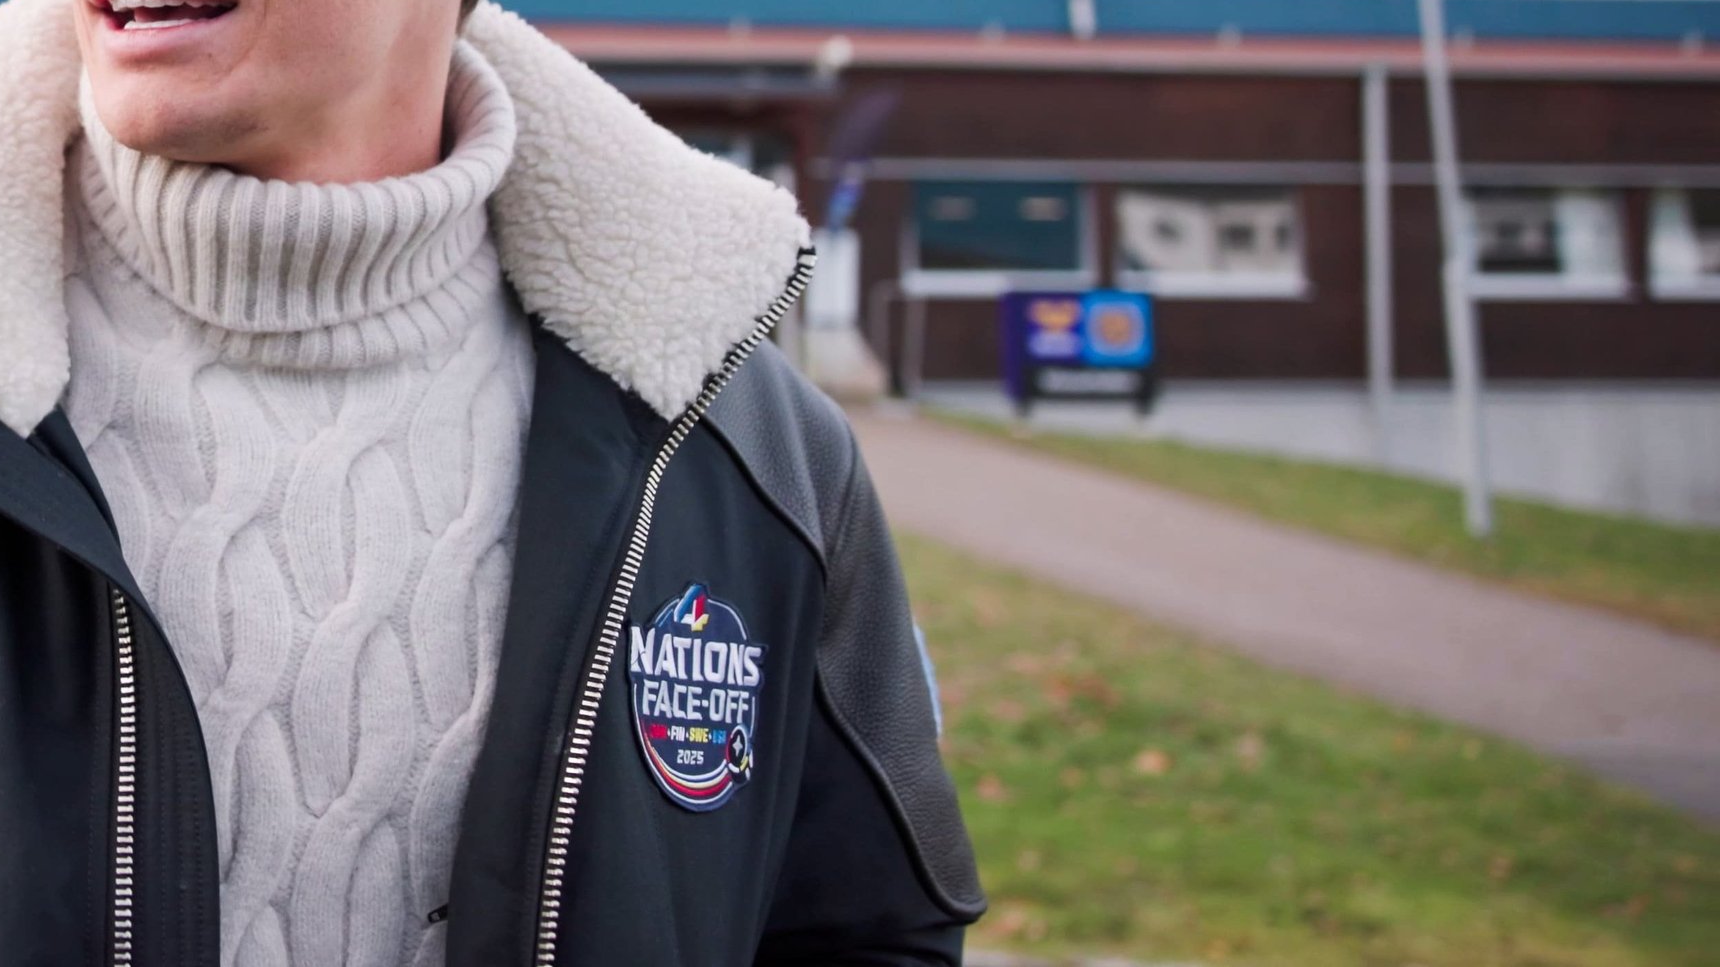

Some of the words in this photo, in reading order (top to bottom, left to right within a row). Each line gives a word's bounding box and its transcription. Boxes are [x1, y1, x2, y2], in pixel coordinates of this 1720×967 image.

[630, 626, 762, 687] NATIONS
[642, 679, 750, 724] FACE-OFF
[676, 749, 705, 765] 2025
